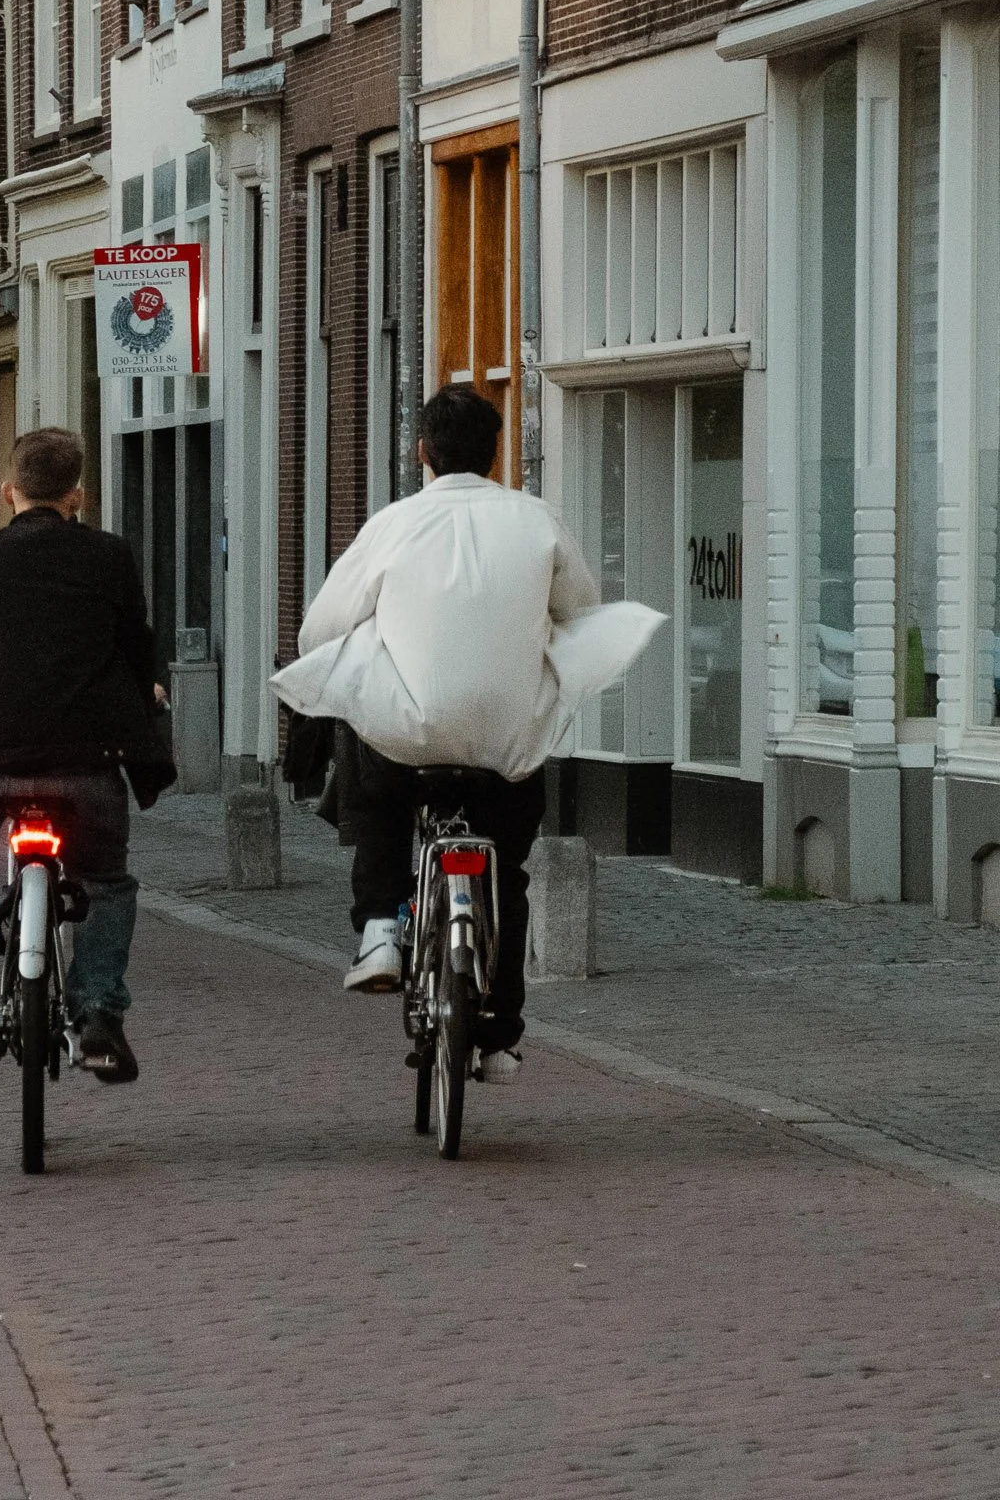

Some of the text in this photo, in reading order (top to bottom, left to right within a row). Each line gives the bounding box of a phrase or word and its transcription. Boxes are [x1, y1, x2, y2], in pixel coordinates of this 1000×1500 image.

[105, 247, 178, 263] TE KOOP
[98, 267, 187, 281] LAUTESLAGER
[140, 291, 159, 307] 175
[138, 305, 153, 313] jaar
[112, 354, 178, 366] 030-231 51 86
[112, 365, 178, 375] LAUTESLAGER.NL
